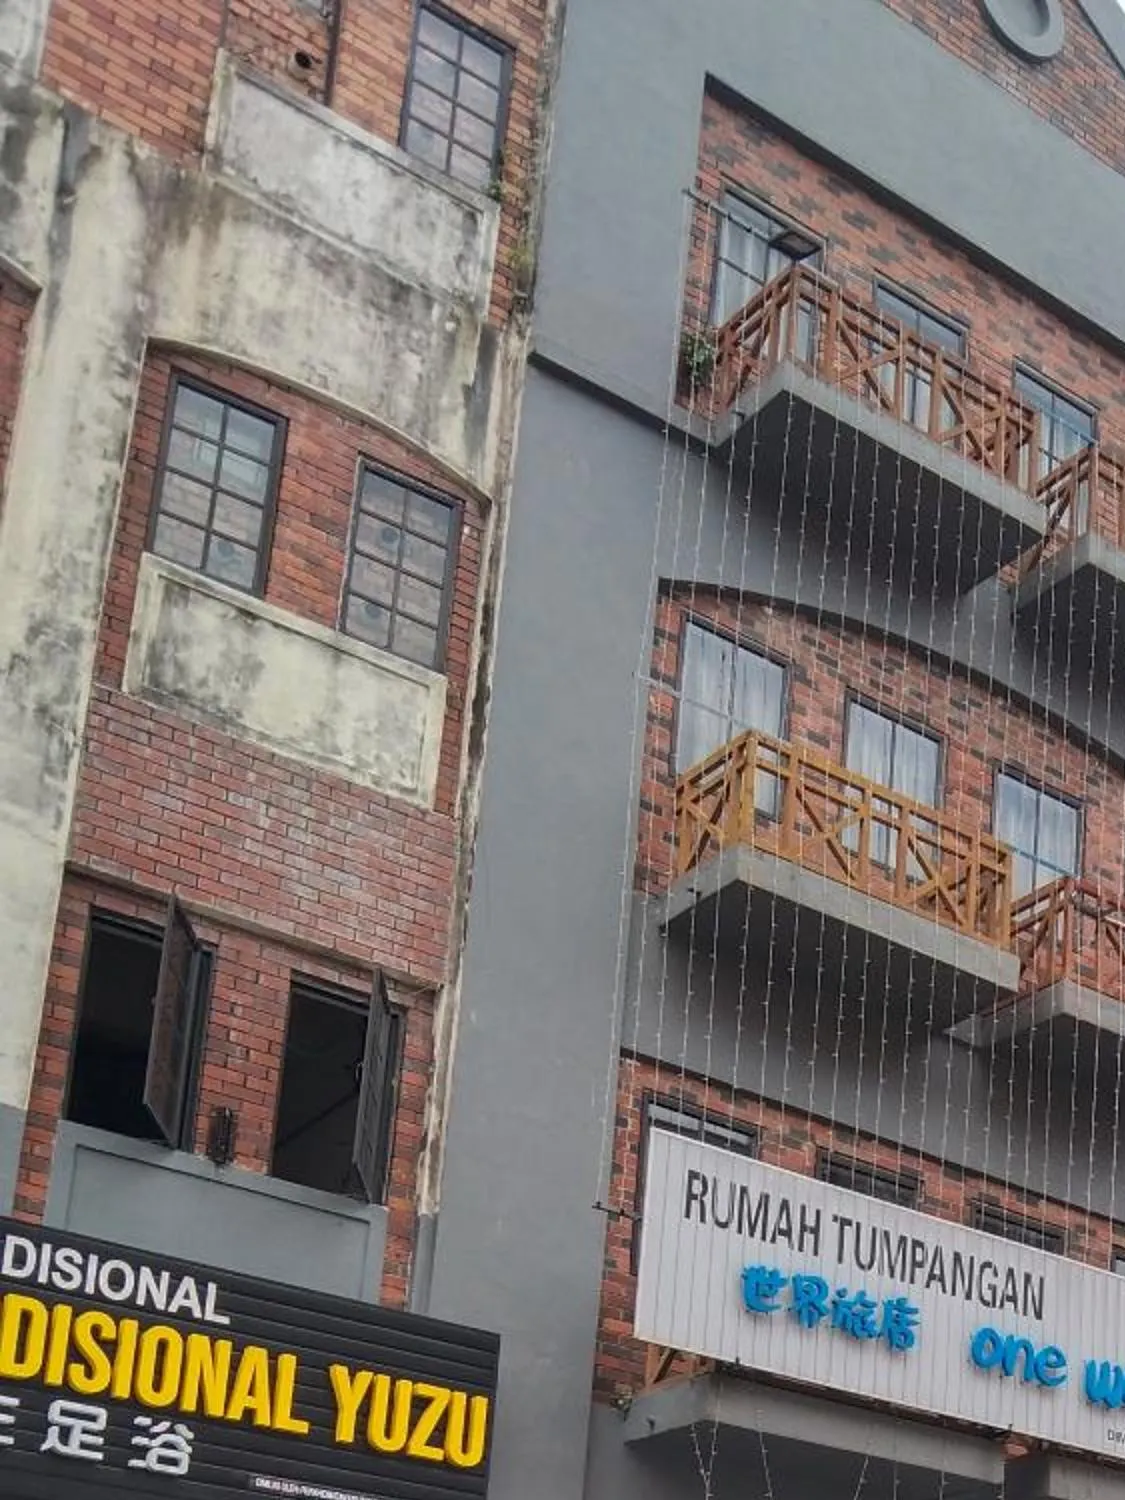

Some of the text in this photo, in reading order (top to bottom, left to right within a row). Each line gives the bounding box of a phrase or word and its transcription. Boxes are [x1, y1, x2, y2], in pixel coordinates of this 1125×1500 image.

[2, 1234, 230, 1325] DISIONAL
[684, 1168, 1045, 1321] RUMAH TUMPANGAN
[0, 1292, 489, 1468] DISIONAL YUZU
[971, 1325, 1068, 1386] one
